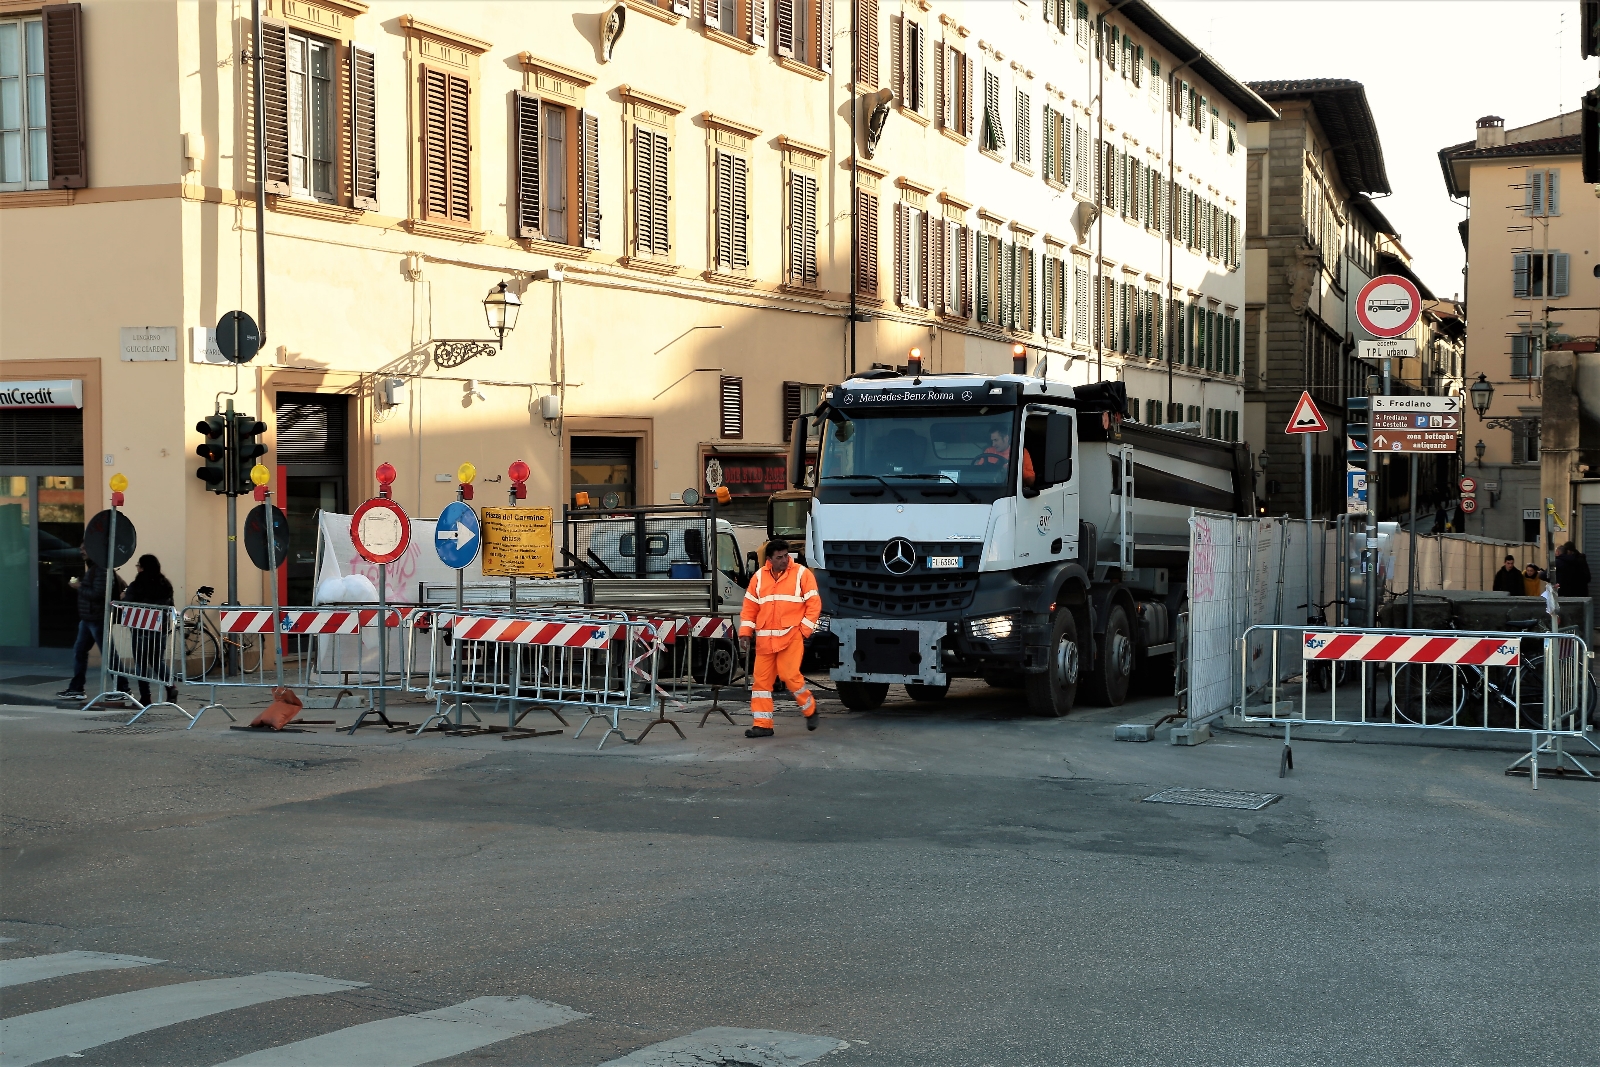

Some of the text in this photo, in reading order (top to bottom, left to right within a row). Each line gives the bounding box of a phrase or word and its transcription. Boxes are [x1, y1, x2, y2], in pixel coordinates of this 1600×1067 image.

[126, 345, 170, 353] GUICCIARDINI
[1386, 347, 1408, 357] urbano
[858, 390, 955, 403] Mercedes-Benz Roma
[1376, 399, 1432, 408] S. Frediano
[1424, 432, 1454, 441] botteghe
[1412, 441, 1447, 449] antiquarie
[724, 467, 741, 484] ONE
[742, 467, 763, 483] EYED
[1464, 501, 1474, 509] 30
[485, 511, 501, 519] Piazza
[514, 514, 545, 522] Carmine
